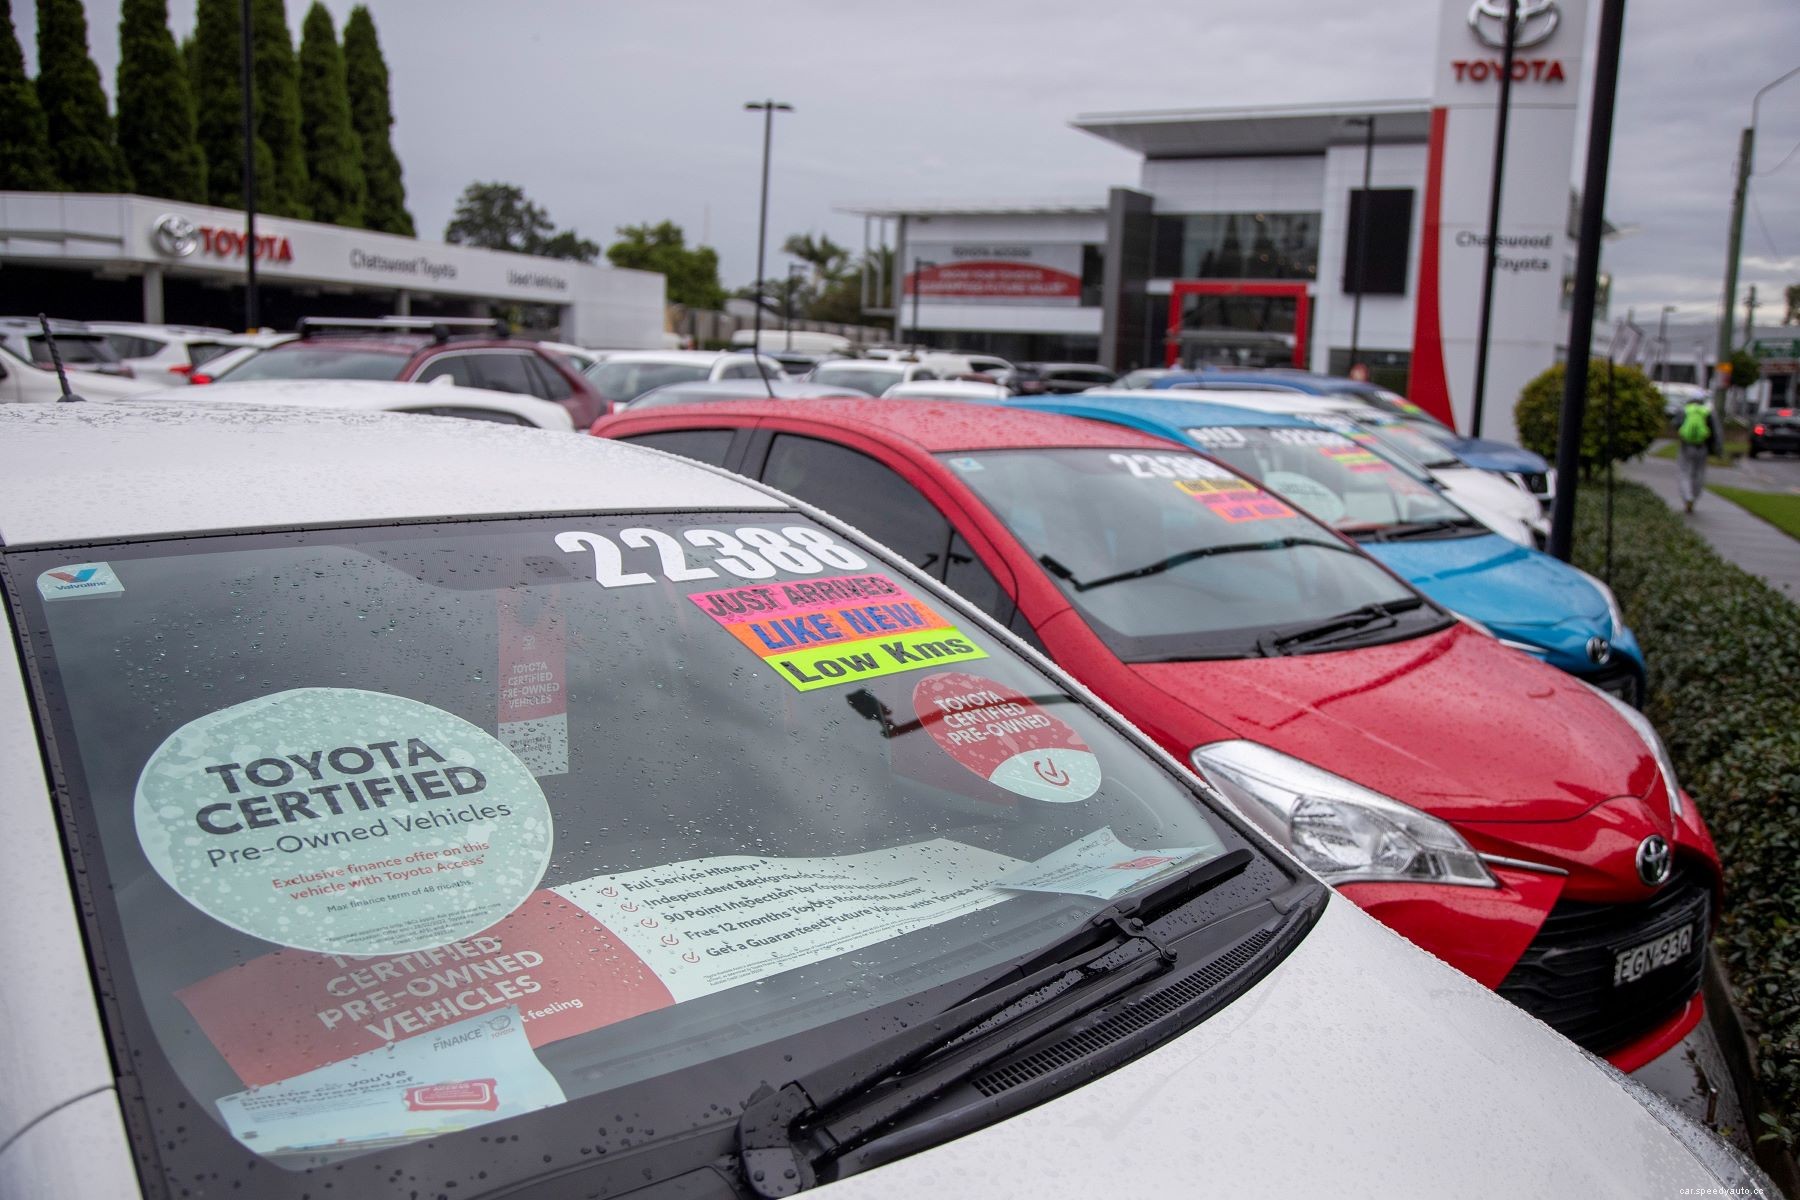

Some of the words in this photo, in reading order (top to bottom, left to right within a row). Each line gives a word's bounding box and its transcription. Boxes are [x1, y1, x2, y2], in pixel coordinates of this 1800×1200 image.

[1452, 60, 1564, 82] TOYOTA
[201, 228, 293, 261] TOYOTA
[1456, 231, 1552, 248] Chaswood
[419, 257, 457, 280] Toyota
[554, 527, 868, 588] 22388
[56, 581, 107, 590] Valvoline
[708, 588, 780, 618] JUST
[786, 575, 900, 603] ARRIVED
[749, 617, 841, 650] LIKE
[844, 603, 925, 634] NEW
[881, 638, 976, 666] Kms
[508, 672, 553, 686] CERTIFIED
[512, 662, 547, 675] TOYOTA
[503, 682, 560, 699] PRE-OWNED
[509, 694, 552, 709] VEHICLES
[934, 690, 1006, 714] TOYOTA
[943, 702, 1027, 729] CERTIFIED
[946, 714, 1051, 746] PRE-OWNED
[205, 738, 447, 793] TOYOTA
[196, 766, 487, 835] CERTIFIED
[207, 819, 388, 867] Pre-Owned
[392, 801, 511, 832] Vehicles
[272, 866, 345, 889] Exclusive
[347, 857, 402, 875] finance
[405, 850, 440, 865] offer
[443, 848, 462, 857] on
[463, 840, 490, 854] this
[290, 880, 346, 900] vehicle
[348, 870, 383, 889] with
[384, 864, 434, 883] Toyota
[621, 879, 652, 893] Full
[654, 871, 702, 887] Service
[643, 883, 738, 908] Independent
[738, 871, 812, 890] Background
[327, 903, 349, 913] Max
[350, 894, 386, 909] finance
[387, 889, 410, 901] term
[412, 887, 423, 896] of
[423, 884, 436, 894] 48
[663, 912, 685, 924] 90
[685, 903, 725, 919] Point
[725, 888, 799, 909] Inspection
[795, 884, 815, 895] by
[683, 927, 720, 942] Free
[720, 922, 736, 933] 12
[737, 909, 791, 929] months
[789, 898, 836, 915] Toyota
[706, 943, 738, 958] Get
[738, 943, 750, 951] a
[746, 919, 831, 947] Guaranteed
[825, 907, 874, 925] Future
[906, 898, 936, 909] with
[931, 888, 974, 902] Toyota
[326, 936, 502, 996] CERTIFIED
[317, 950, 544, 1031] PRE-OWNED
[364, 975, 542, 1042] VEHICLES
[528, 997, 584, 1022] feeling
[433, 1029, 482, 1052] FINANCE
[347, 1069, 407, 1087] you've
[395, 1076, 414, 1085] of
